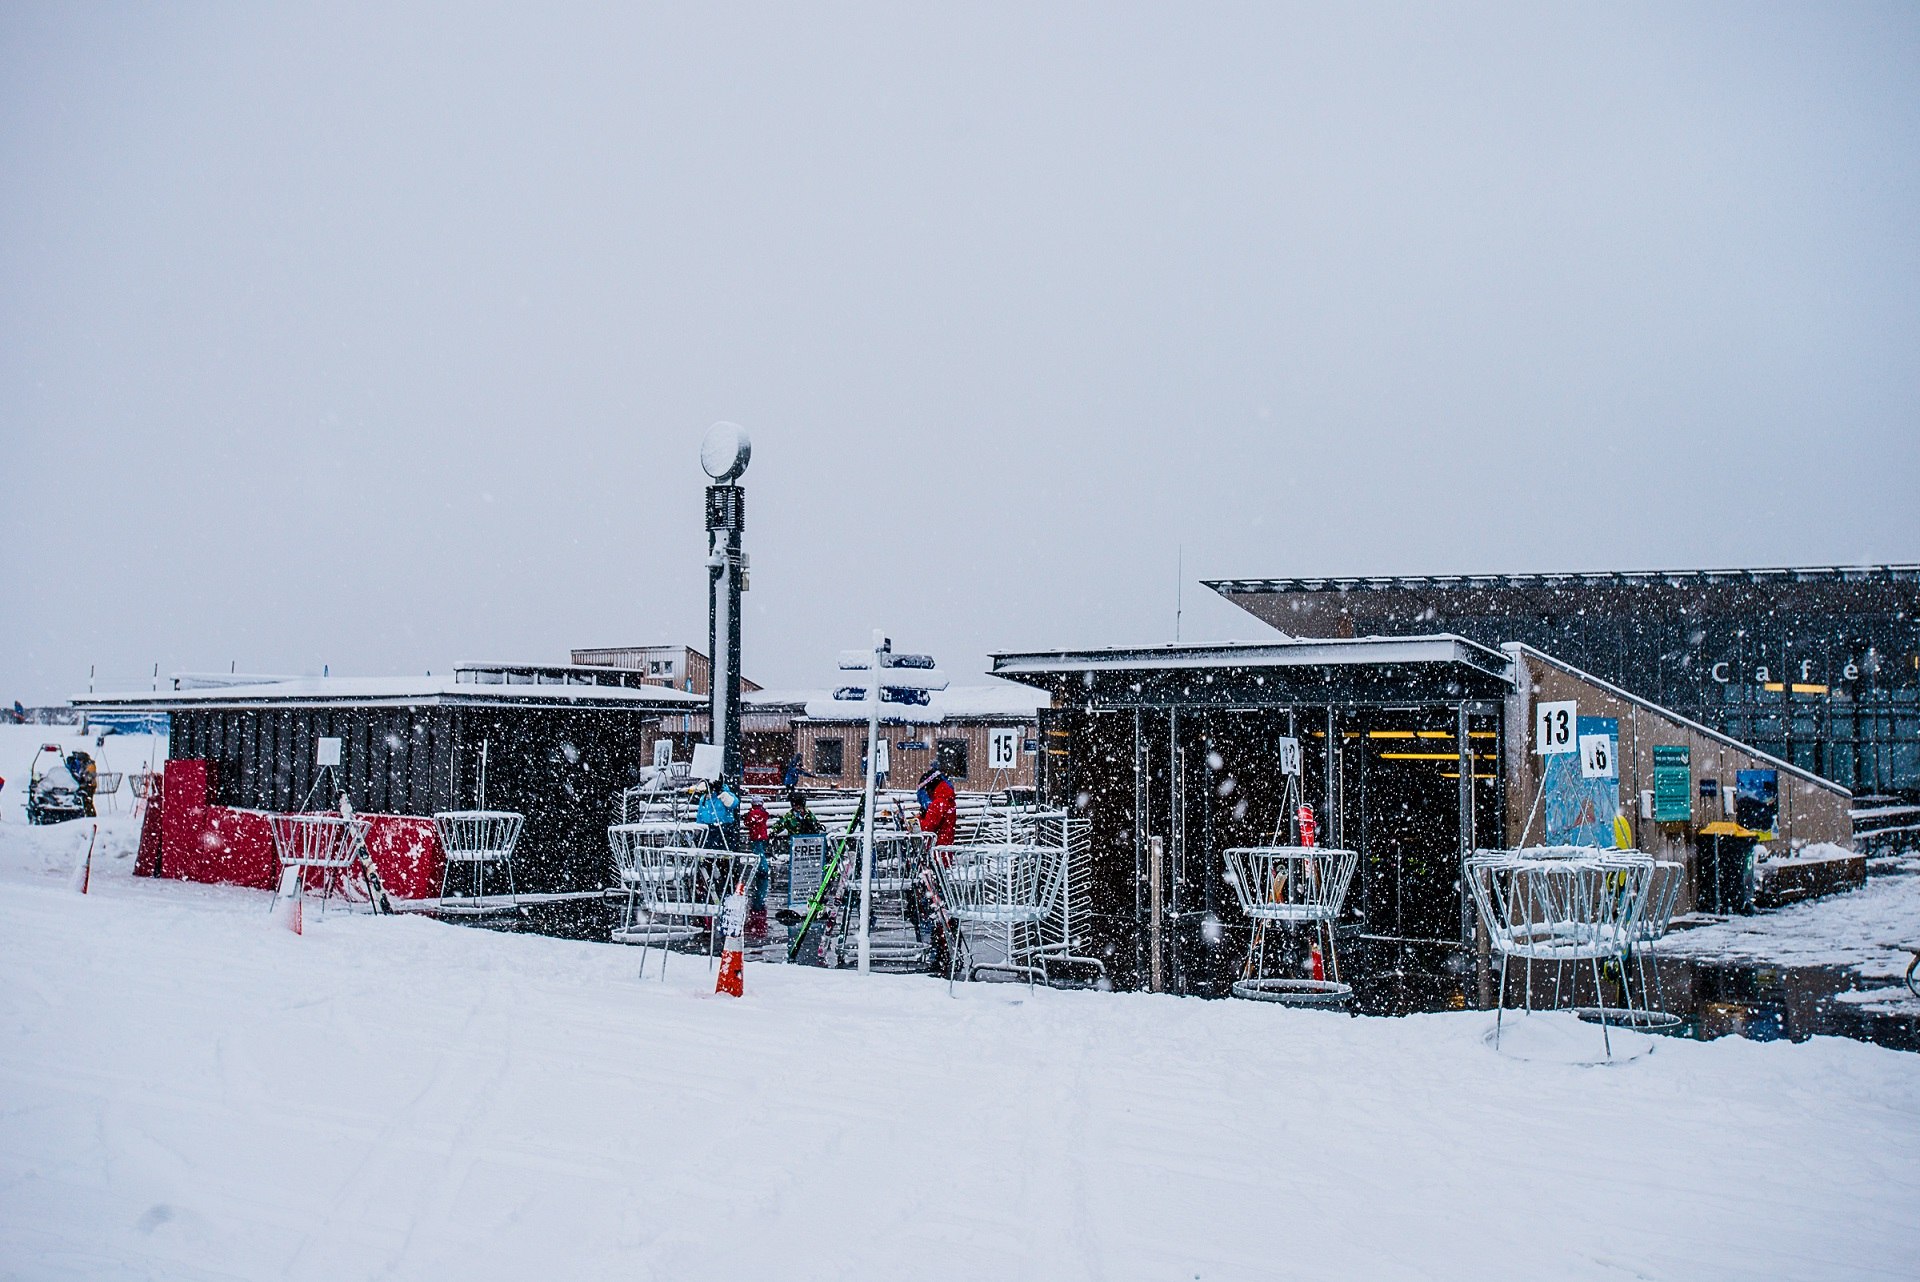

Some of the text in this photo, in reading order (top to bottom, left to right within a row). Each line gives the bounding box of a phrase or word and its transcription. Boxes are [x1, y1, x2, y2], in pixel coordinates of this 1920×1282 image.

[1711, 658, 1859, 683] Café
[1542, 709, 1570, 746] 13
[994, 734, 1013, 763] 15
[793, 844, 822, 857] FREE
